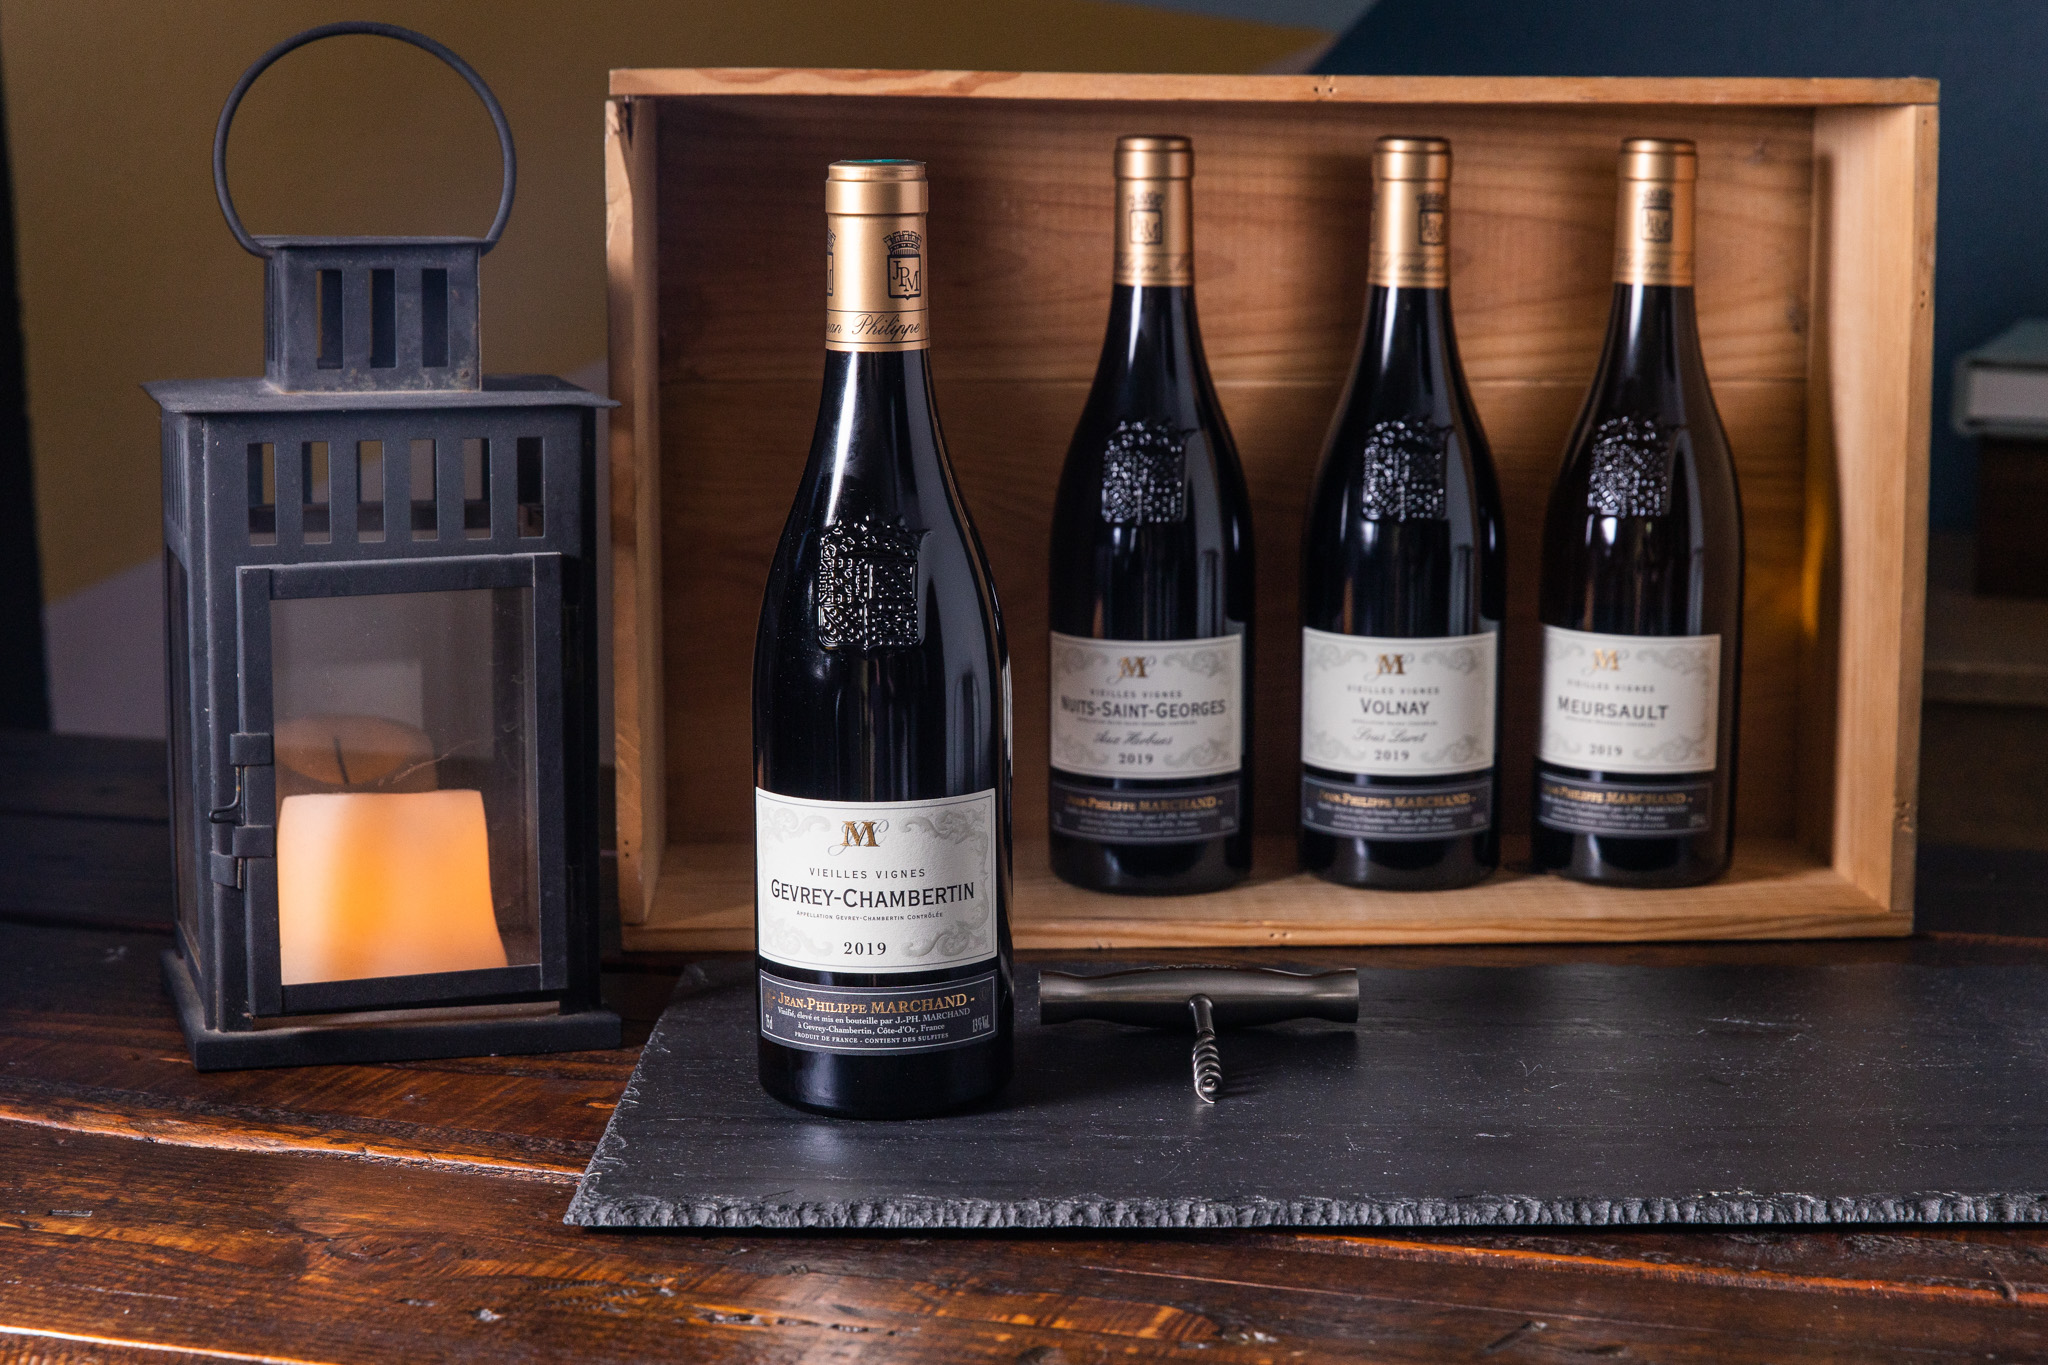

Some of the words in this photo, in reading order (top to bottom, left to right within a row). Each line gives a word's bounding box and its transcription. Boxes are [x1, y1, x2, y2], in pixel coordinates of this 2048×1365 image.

[1061, 696, 1226, 719] NUITS-SAINT-GEORGES
[1361, 698, 1430, 715] VOLNAY
[1558, 695, 1669, 720] MEURSAULT
[1374, 749, 1410, 761] 2019
[1590, 743, 1623, 756] 2019
[1118, 752, 1154, 765] 2019
[809, 867, 867, 879] VIEILLES
[876, 868, 926, 879] VIGNES
[771, 878, 975, 908] GEVREY-CHAMBERTIN
[796, 910, 833, 920] APPELLATION
[835, 914, 905, 922] GEVREY-CHAMBERTIN
[906, 911, 944, 920] CONTRÔLÉE
[843, 941, 887, 956] 2019
[870, 993, 967, 1014] MARCHAND
[797, 1011, 812, 1021] élevé
[821, 1015, 834, 1023] mis
[845, 1016, 877, 1025] bouteille
[879, 1018, 893, 1026] par
[922, 1007, 971, 1022] MARCHAND
[803, 1021, 875, 1035] Gevrey-Chambertin,
[877, 1025, 919, 1034] Côte-d'Or,
[920, 1024, 945, 1032] France
[794, 1031, 819, 1040] PRODUIT
